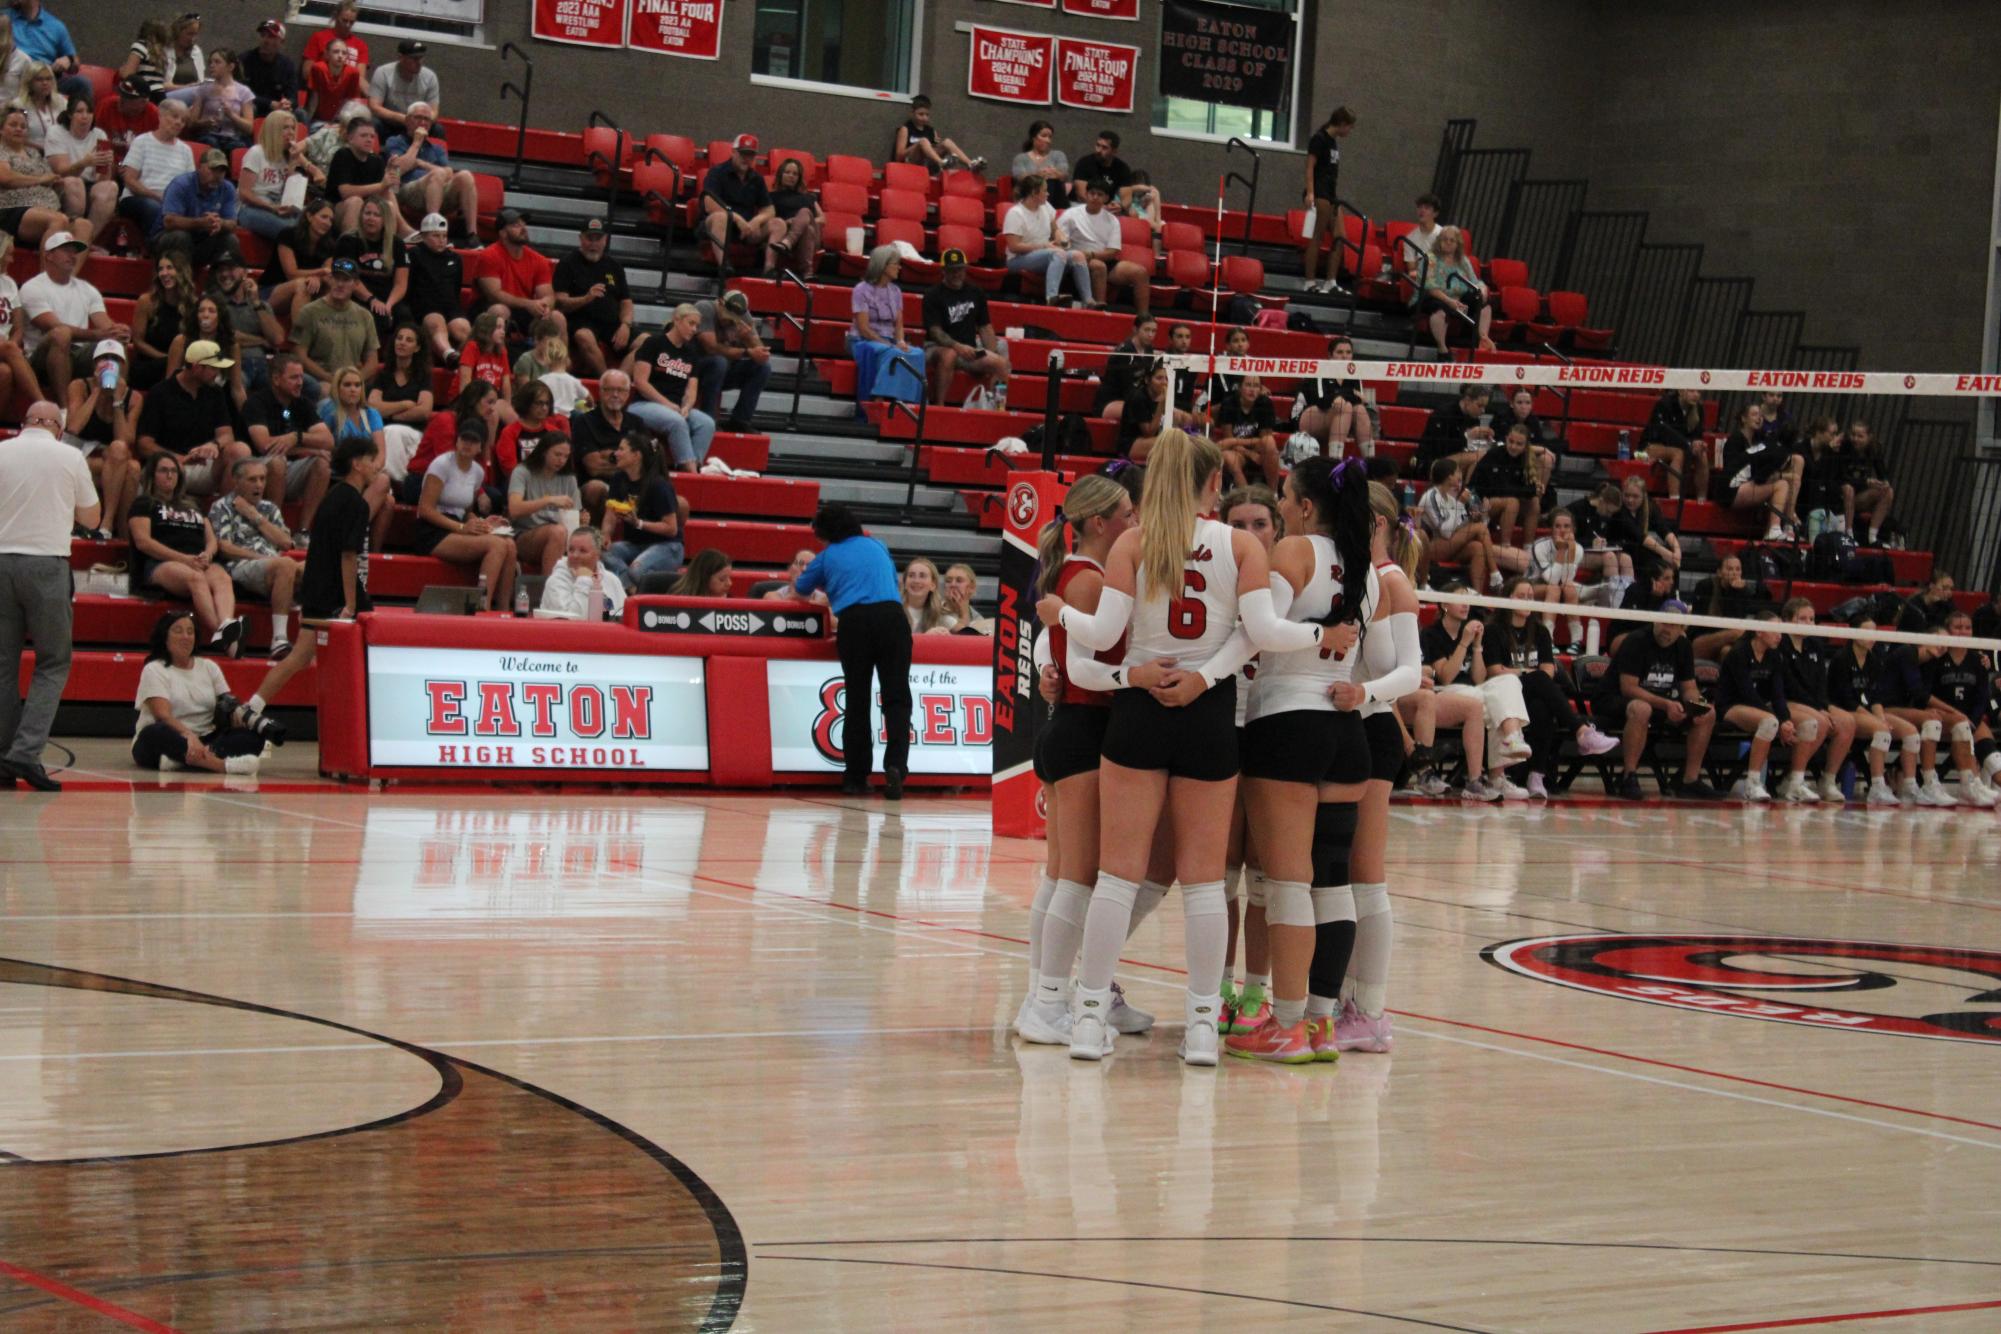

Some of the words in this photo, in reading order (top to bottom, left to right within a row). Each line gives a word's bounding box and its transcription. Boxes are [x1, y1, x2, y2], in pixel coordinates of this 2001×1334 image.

[557, 2, 579, 15] 2023
[582, 4, 600, 17] AAA
[681, 3, 714, 22] FOUR
[555, 14, 600, 29] WRESTLING
[660, 16, 679, 27] 2023
[680, 17, 692, 28] AA
[1196, 17, 1257, 40] EATON
[565, 26, 588, 37] EATON
[658, 26, 690, 38] FOOTBALL
[663, 36, 684, 46] EATON
[1000, 37, 1027, 50] STATE
[1163, 31, 1212, 52] HIGH
[1216, 39, 1289, 62] SCHOOL
[980, 40, 1044, 68] CHAMPIONS
[1084, 47, 1111, 60] STATE
[991, 61, 1012, 75] 2024
[1013, 63, 1030, 77] AAA
[1064, 51, 1097, 72] FINAL
[1098, 59, 1128, 81] FOUR
[1181, 52, 1237, 73] CLASS
[1242, 61, 1267, 77] OF
[993, 73, 1026, 87] BASEBALL
[1077, 70, 1097, 84] 2024
[1098, 72, 1114, 86] AAA
[1203, 73, 1244, 92] 2029
[1000, 84, 1020, 95] EATON
[1073, 82, 1095, 94] GIRLS
[1095, 84, 1116, 96] TRACK
[1229, 357, 1276, 373] EATON
[1278, 360, 1318, 375] REDS
[1386, 363, 1438, 378] EATON
[1440, 365, 1483, 380] REDS
[1558, 367, 1614, 383] EATON
[1617, 368, 1665, 384] REDS
[1746, 371, 1810, 387] EATON
[1812, 373, 1865, 389] REDS
[1168, 570, 1207, 640] 6
[657, 614, 677, 625] BONUS
[716, 614, 748, 631] POSS
[786, 620, 805, 630] BONUS
[499, 656, 562, 673] Welcome
[566, 657, 579, 673] to
[994, 583, 1018, 734] EATON
[1016, 618, 1033, 701] REDS
[922, 670, 936, 688] of
[939, 671, 958, 684] the
[1955, 686, 1965, 701] 5
[425, 680, 653, 740] EATON
[876, 692, 994, 746] ED
[438, 745, 514, 764] HIGH
[531, 747, 645, 766] SCHOOL
